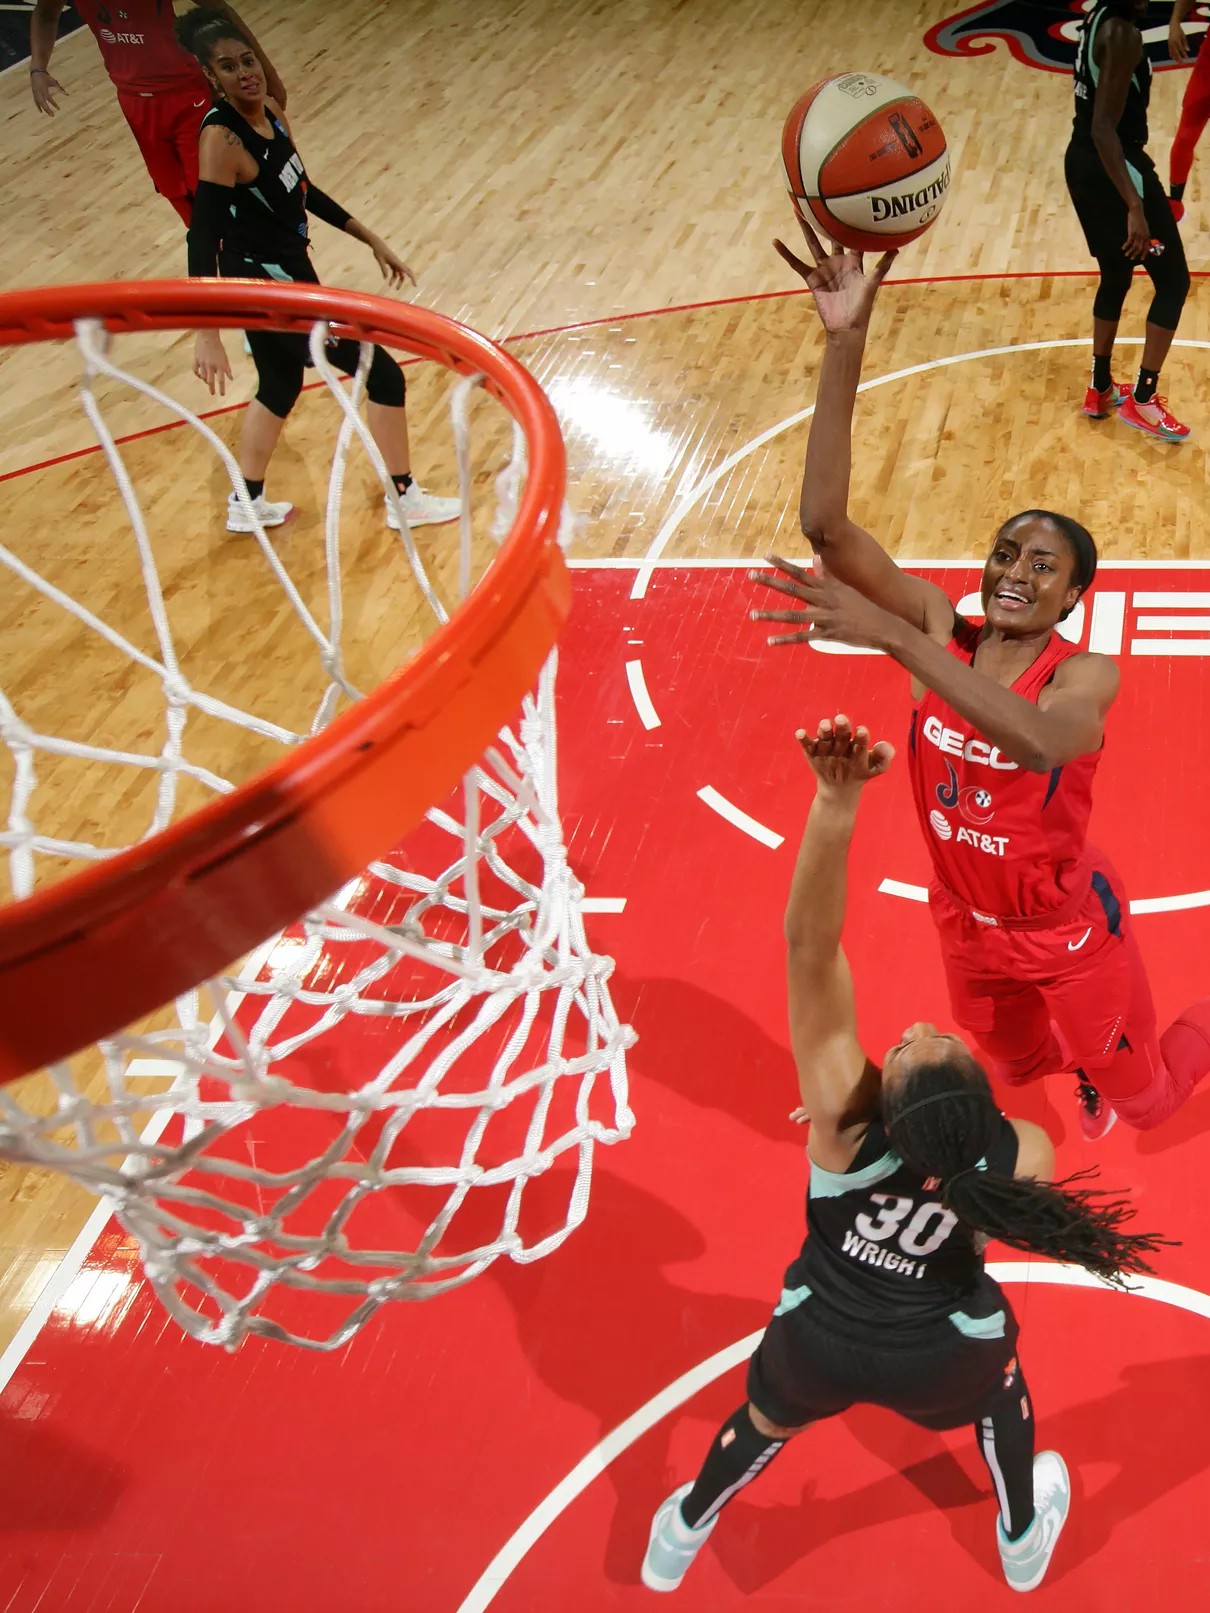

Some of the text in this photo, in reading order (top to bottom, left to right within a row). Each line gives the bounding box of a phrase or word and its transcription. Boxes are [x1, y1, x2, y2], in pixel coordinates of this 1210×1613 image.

[117, 33, 145, 44] AT&T
[956, 827, 1009, 857] AT&T
[855, 1193, 959, 1256] 30
